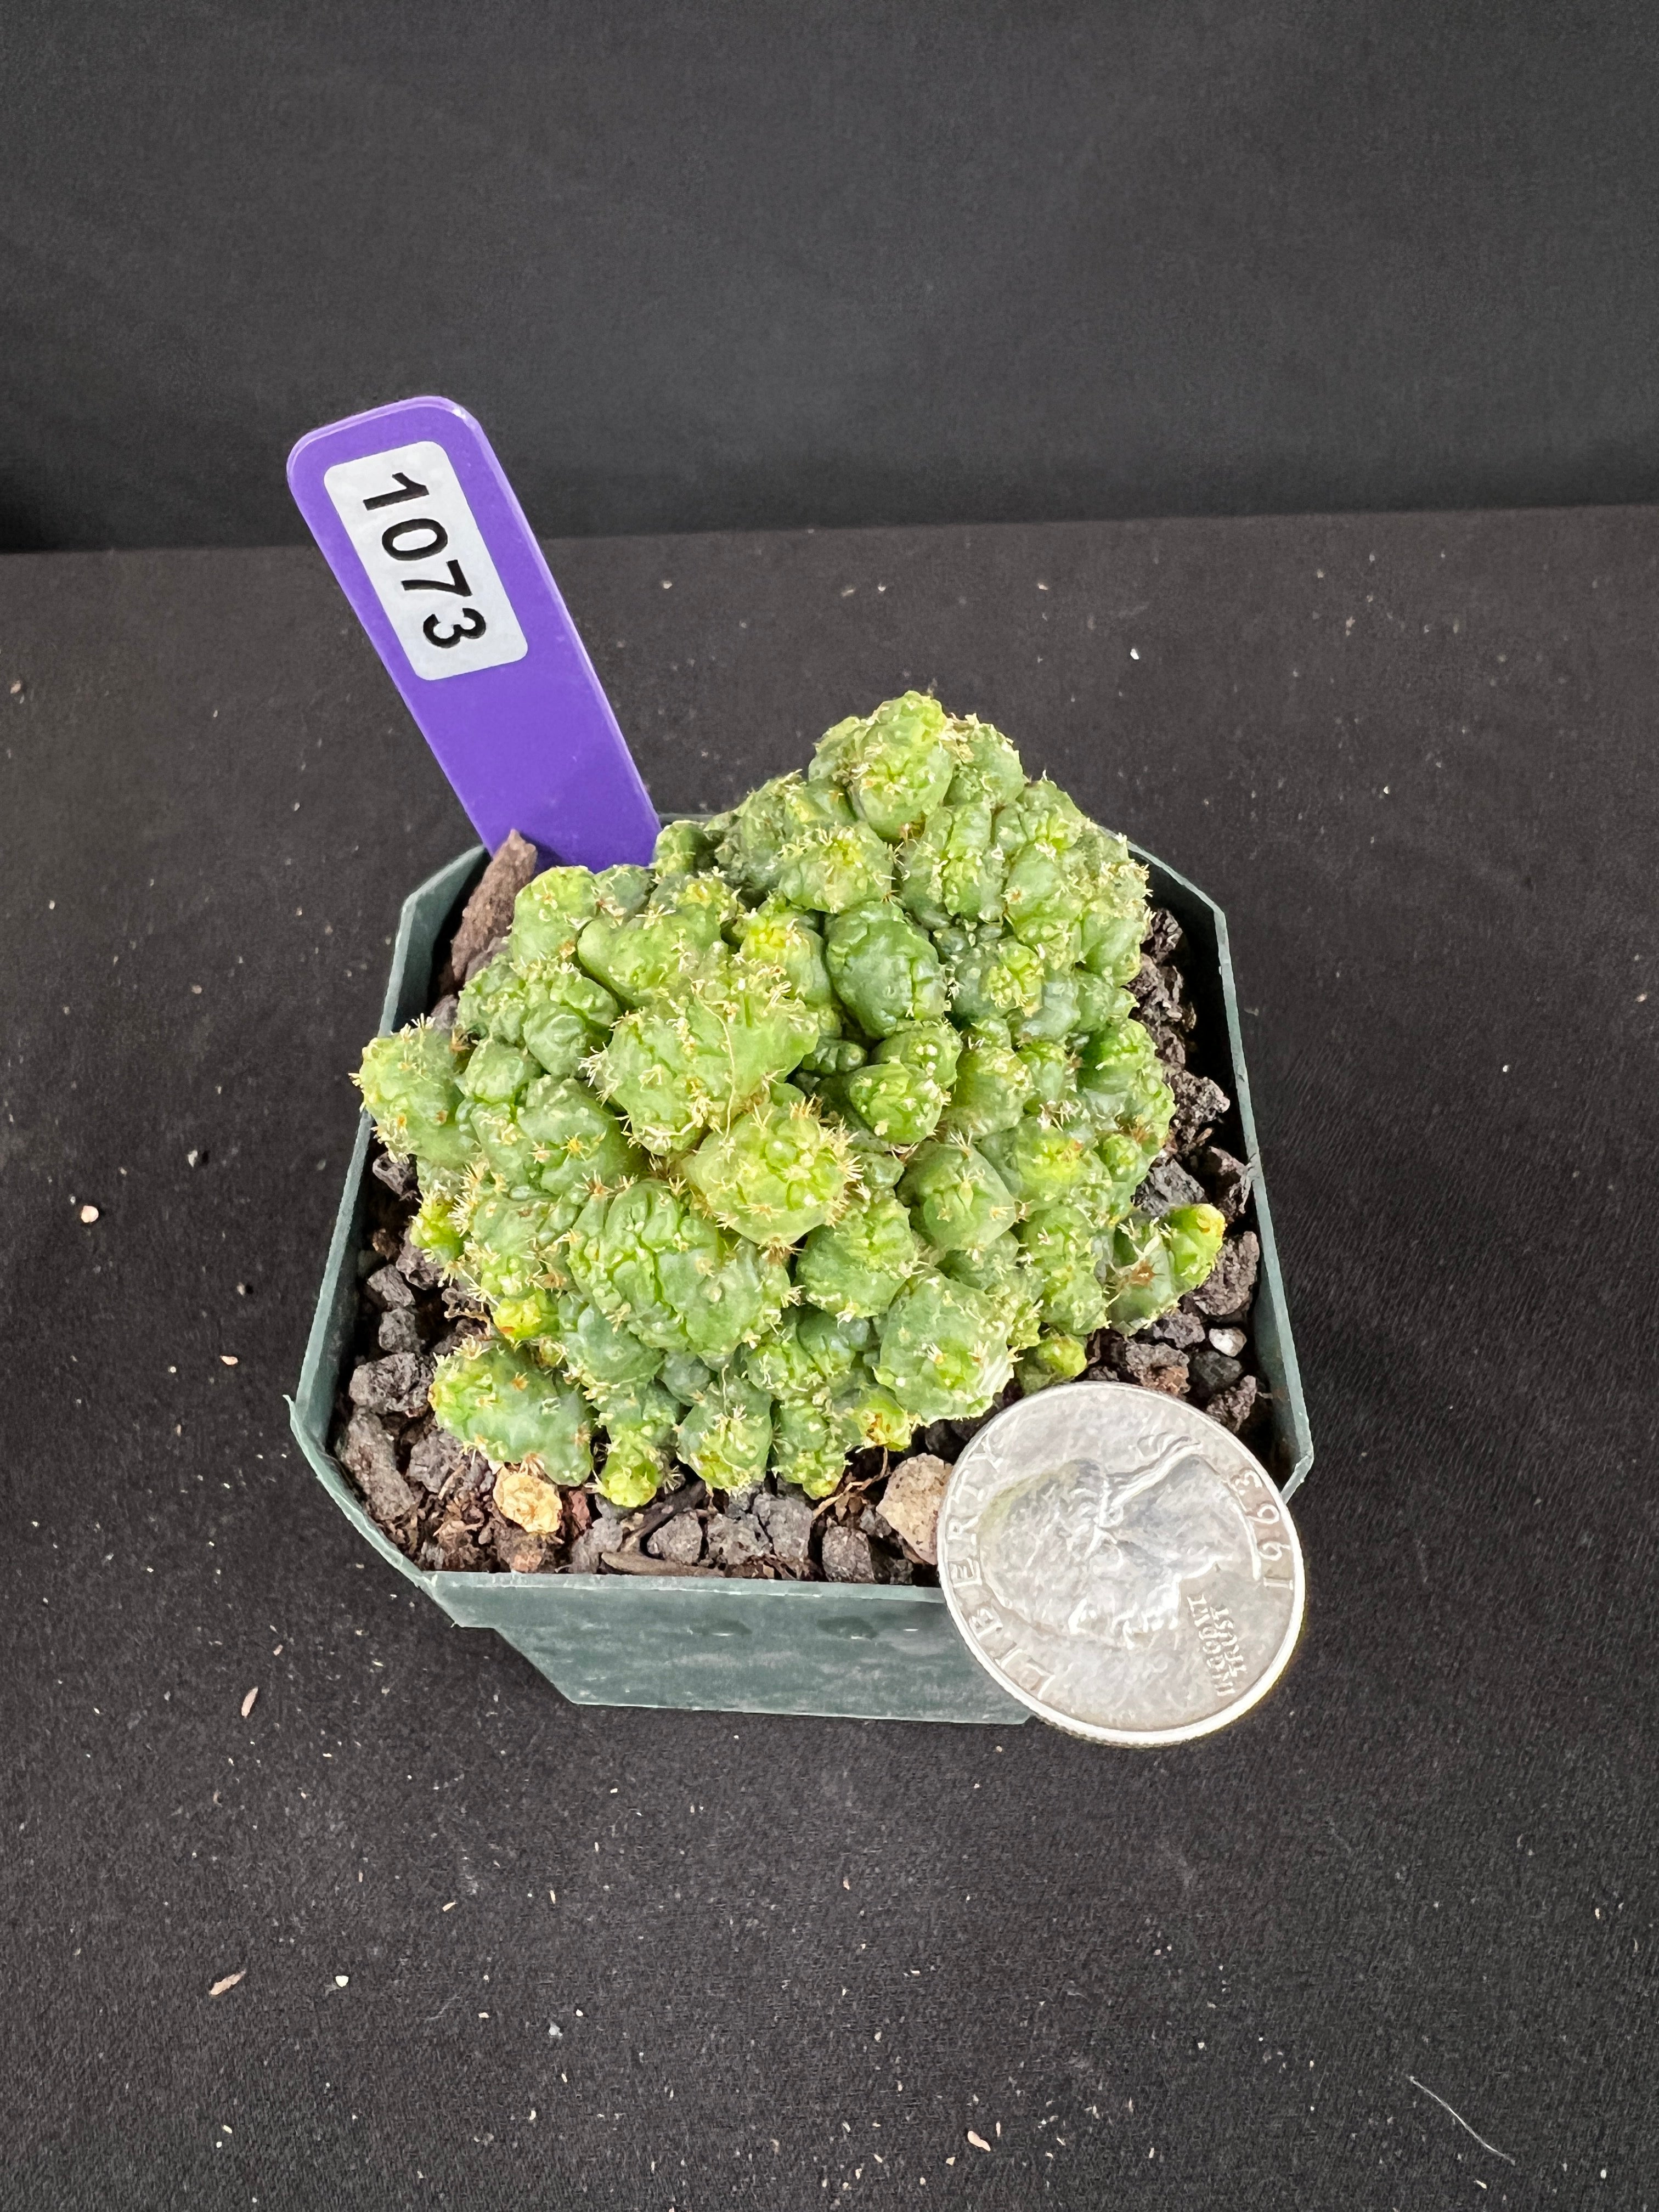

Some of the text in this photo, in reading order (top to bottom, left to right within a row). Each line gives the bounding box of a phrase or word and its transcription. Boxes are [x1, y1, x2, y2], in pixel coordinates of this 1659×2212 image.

[363, 472, 487, 649] 1073
[946, 1432, 1055, 1699] LIBERTY
[1210, 1606, 1248, 1678] TRUST
